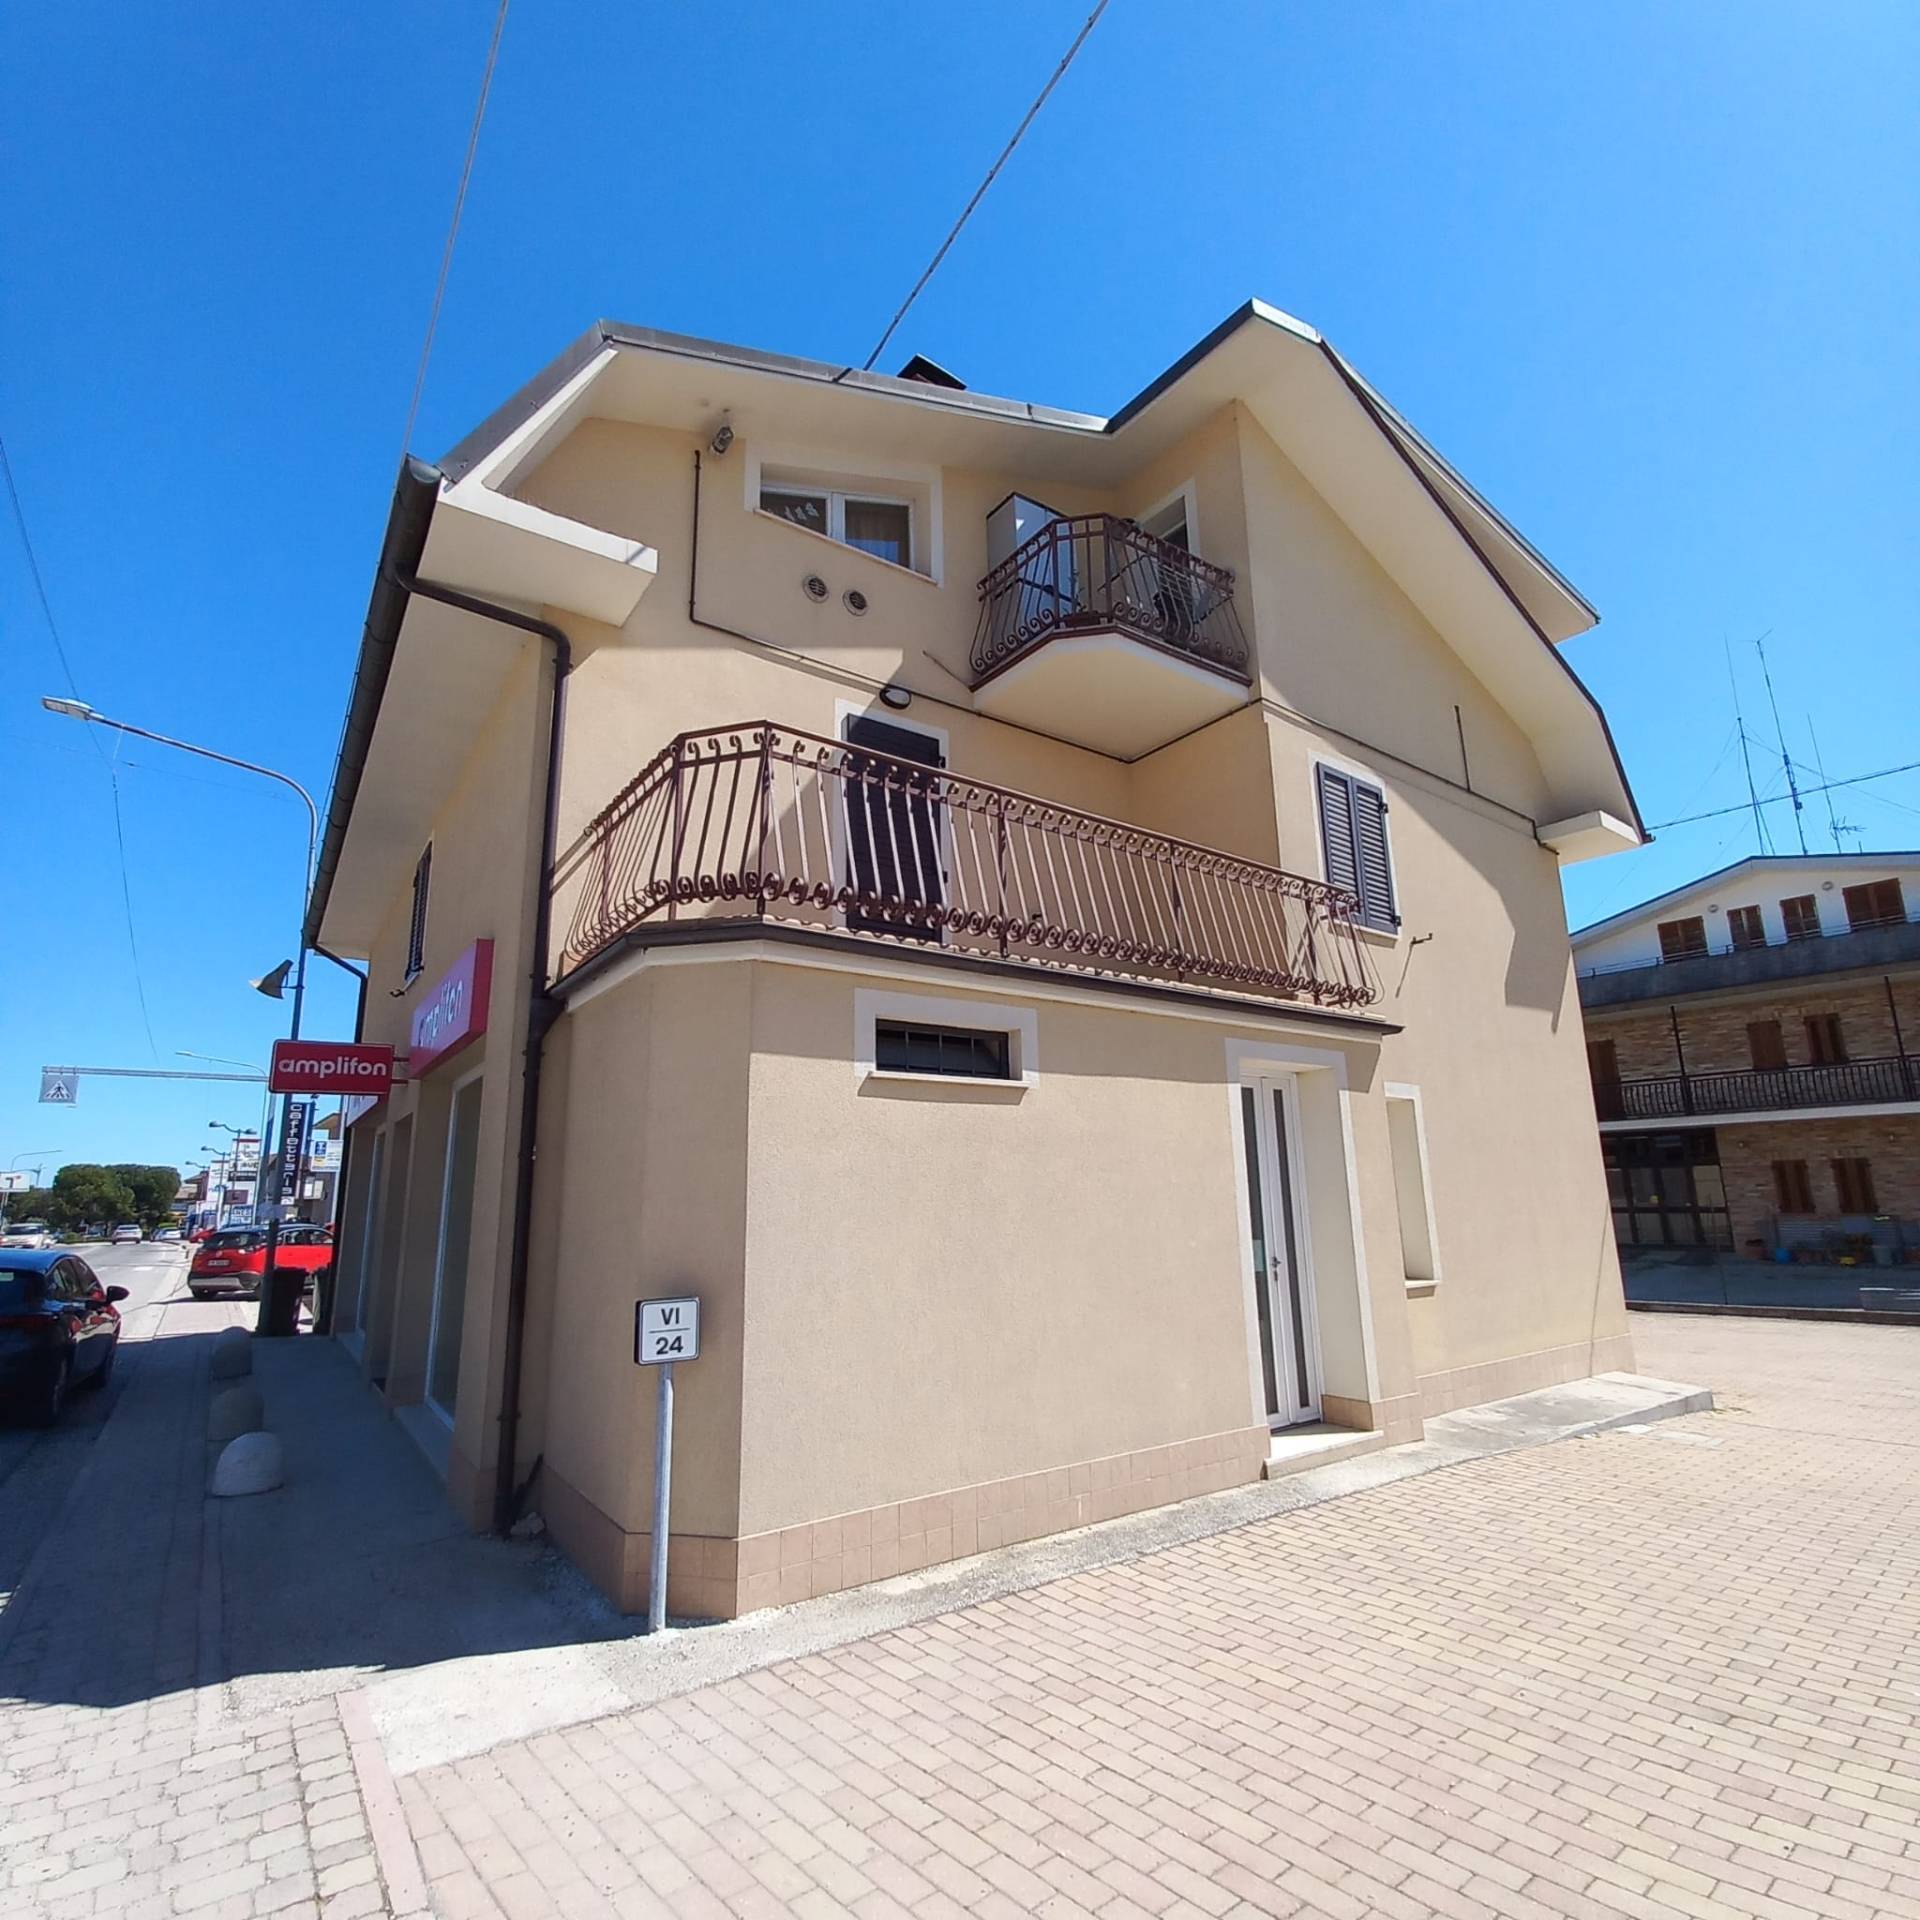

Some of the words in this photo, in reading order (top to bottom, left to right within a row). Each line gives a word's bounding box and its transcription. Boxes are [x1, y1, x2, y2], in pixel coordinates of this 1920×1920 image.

[278, 1056, 387, 1078] amplifon
[661, 1307, 680, 1325] VI
[656, 1336, 684, 1355] 24
